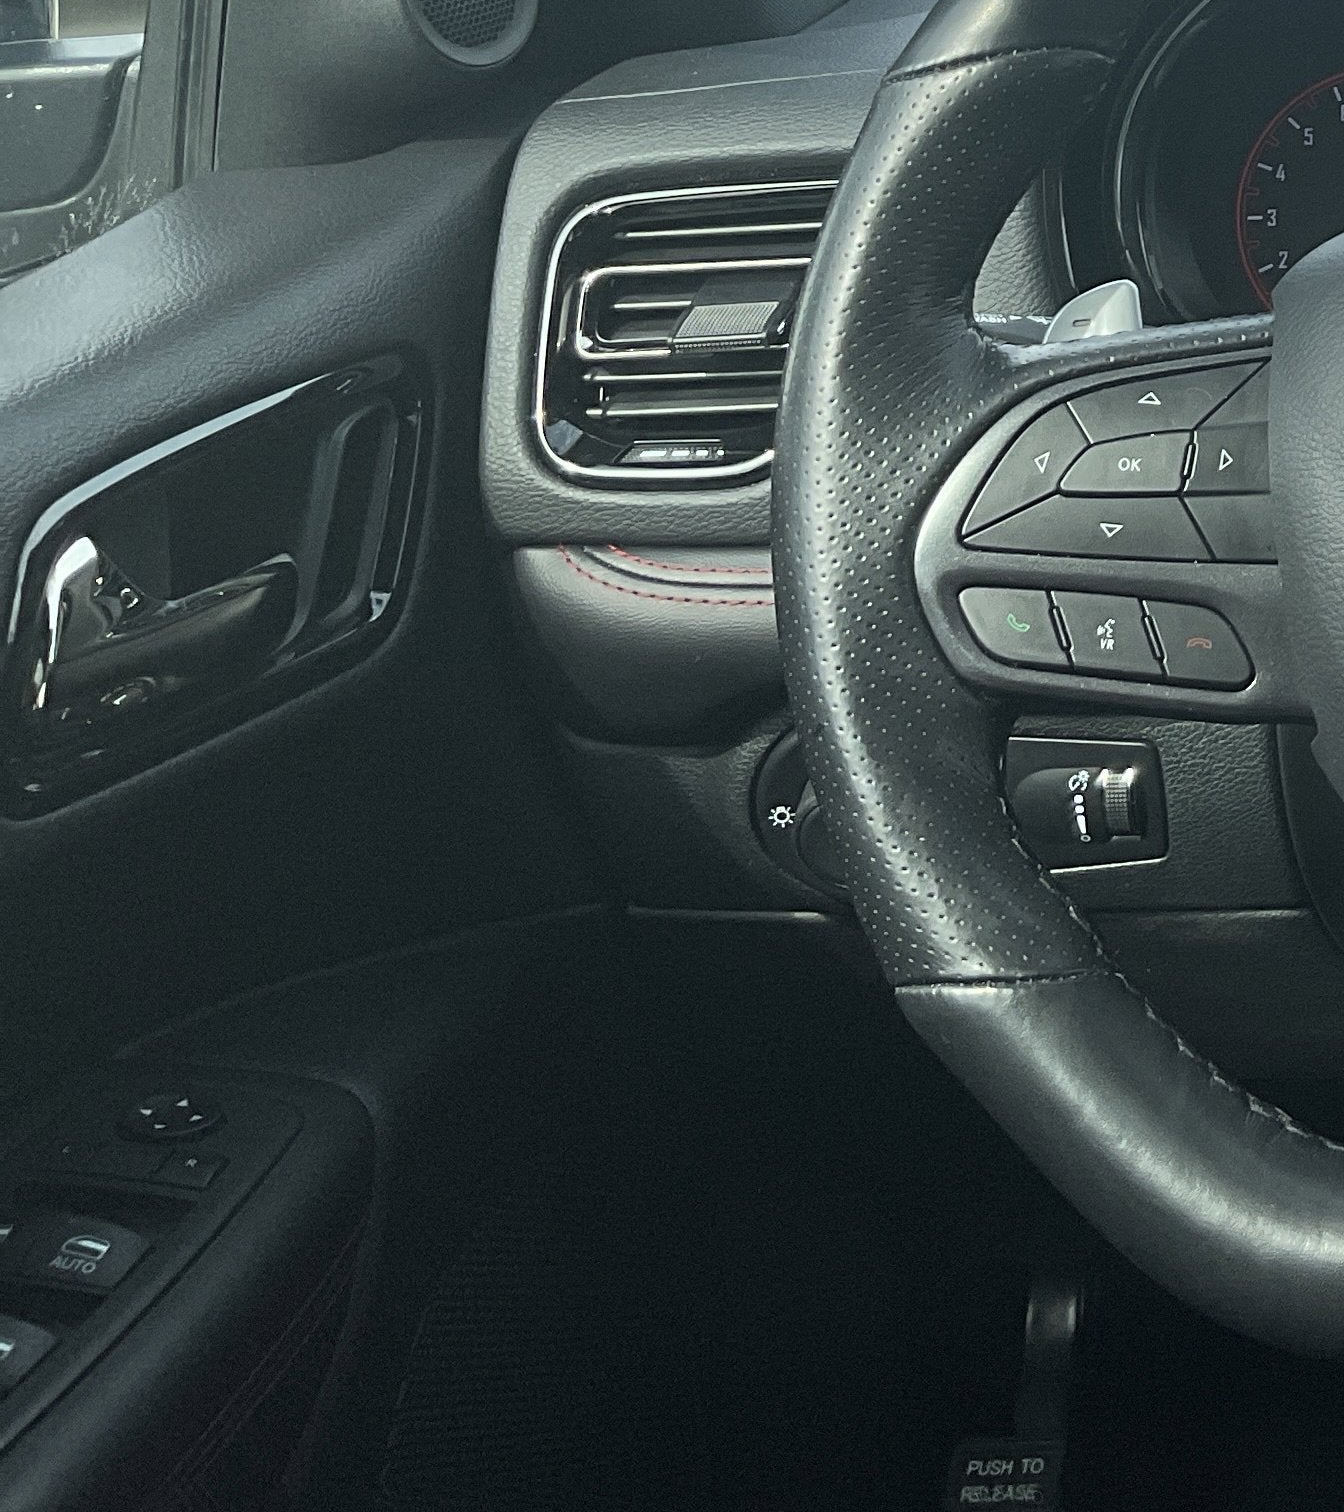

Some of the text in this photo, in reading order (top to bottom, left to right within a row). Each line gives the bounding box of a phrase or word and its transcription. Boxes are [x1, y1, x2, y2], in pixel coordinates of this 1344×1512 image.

[1303, 127, 1314, 146] 5
[1275, 163, 1286, 182] 4
[1267, 208, 1277, 227] 3
[1278, 250, 1288, 269] 2
[1118, 456, 1142, 473] OK
[1100, 637, 1116, 652] VR
[49, 1255, 97, 1274] AUTO
[966, 1458, 1045, 1476] PUSH TO
[960, 1483, 1041, 1504] RELEASE
